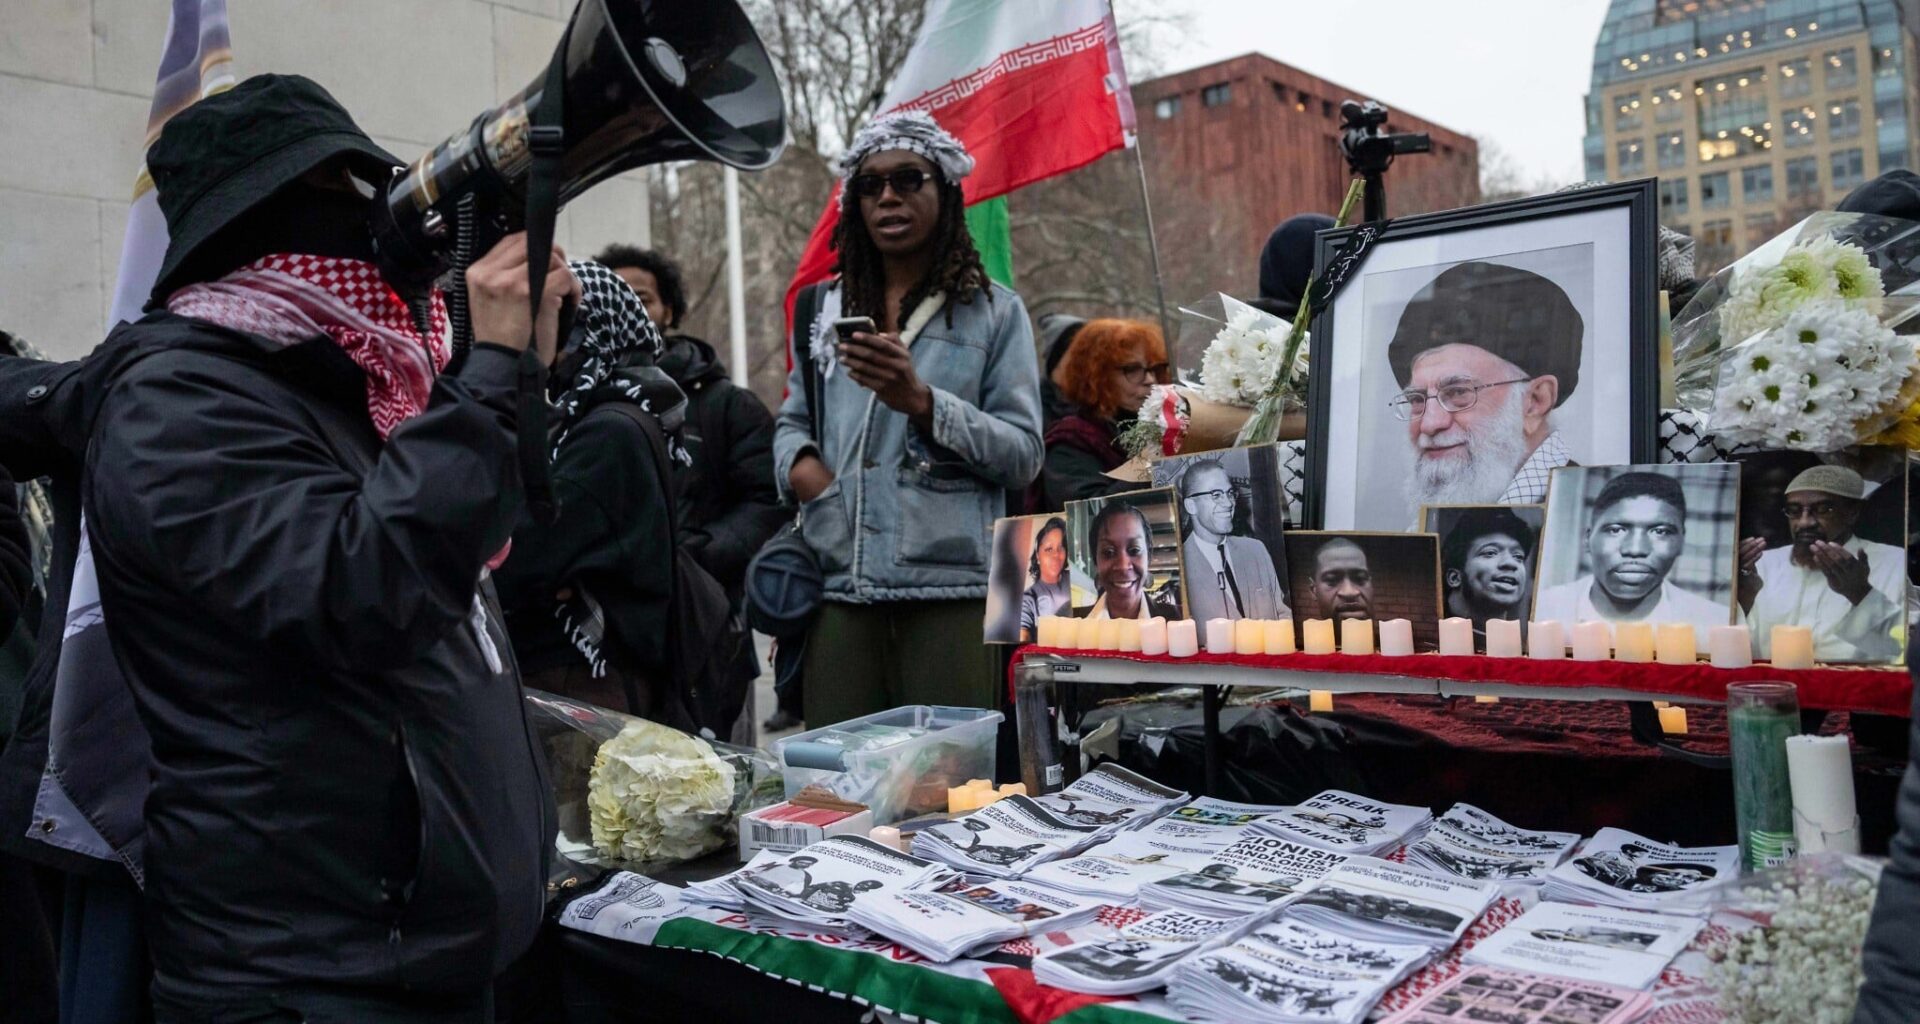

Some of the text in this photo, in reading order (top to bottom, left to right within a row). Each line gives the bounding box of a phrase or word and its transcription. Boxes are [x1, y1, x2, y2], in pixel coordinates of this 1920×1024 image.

[1305, 801, 1333, 811] DE
[1316, 793, 1392, 815] BREAK
[1266, 818, 1350, 845] CHAINS
[1231, 842, 1270, 854] AND
[1271, 850, 1338, 868] RACIST
[1237, 836, 1349, 863] ZIONISM
[1634, 840, 1672, 854] GEORGE
[1217, 852, 1250, 863] ABUSE
[1251, 859, 1282, 870] FROM
[1260, 867, 1322, 879] BROOKLYN
[1155, 917, 1195, 930] AND
